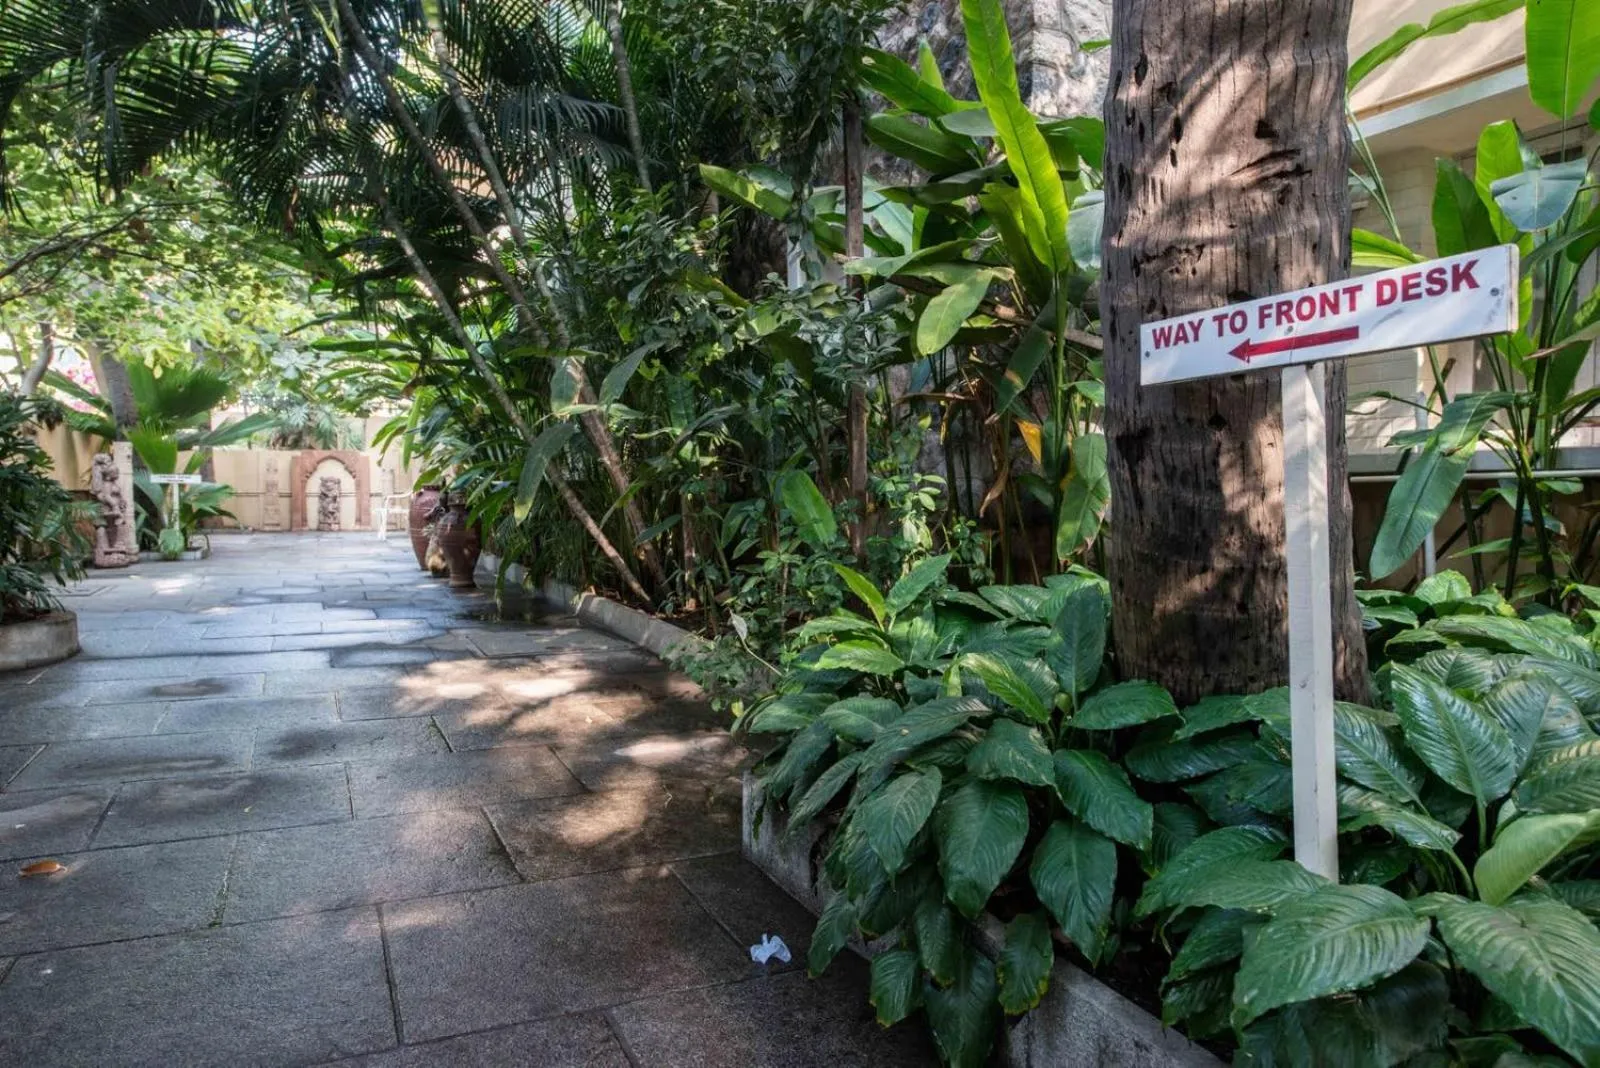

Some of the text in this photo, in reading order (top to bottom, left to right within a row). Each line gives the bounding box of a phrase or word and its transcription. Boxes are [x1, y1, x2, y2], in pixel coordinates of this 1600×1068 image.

[1152, 259, 1480, 349] WAY TO FRONT DESK
